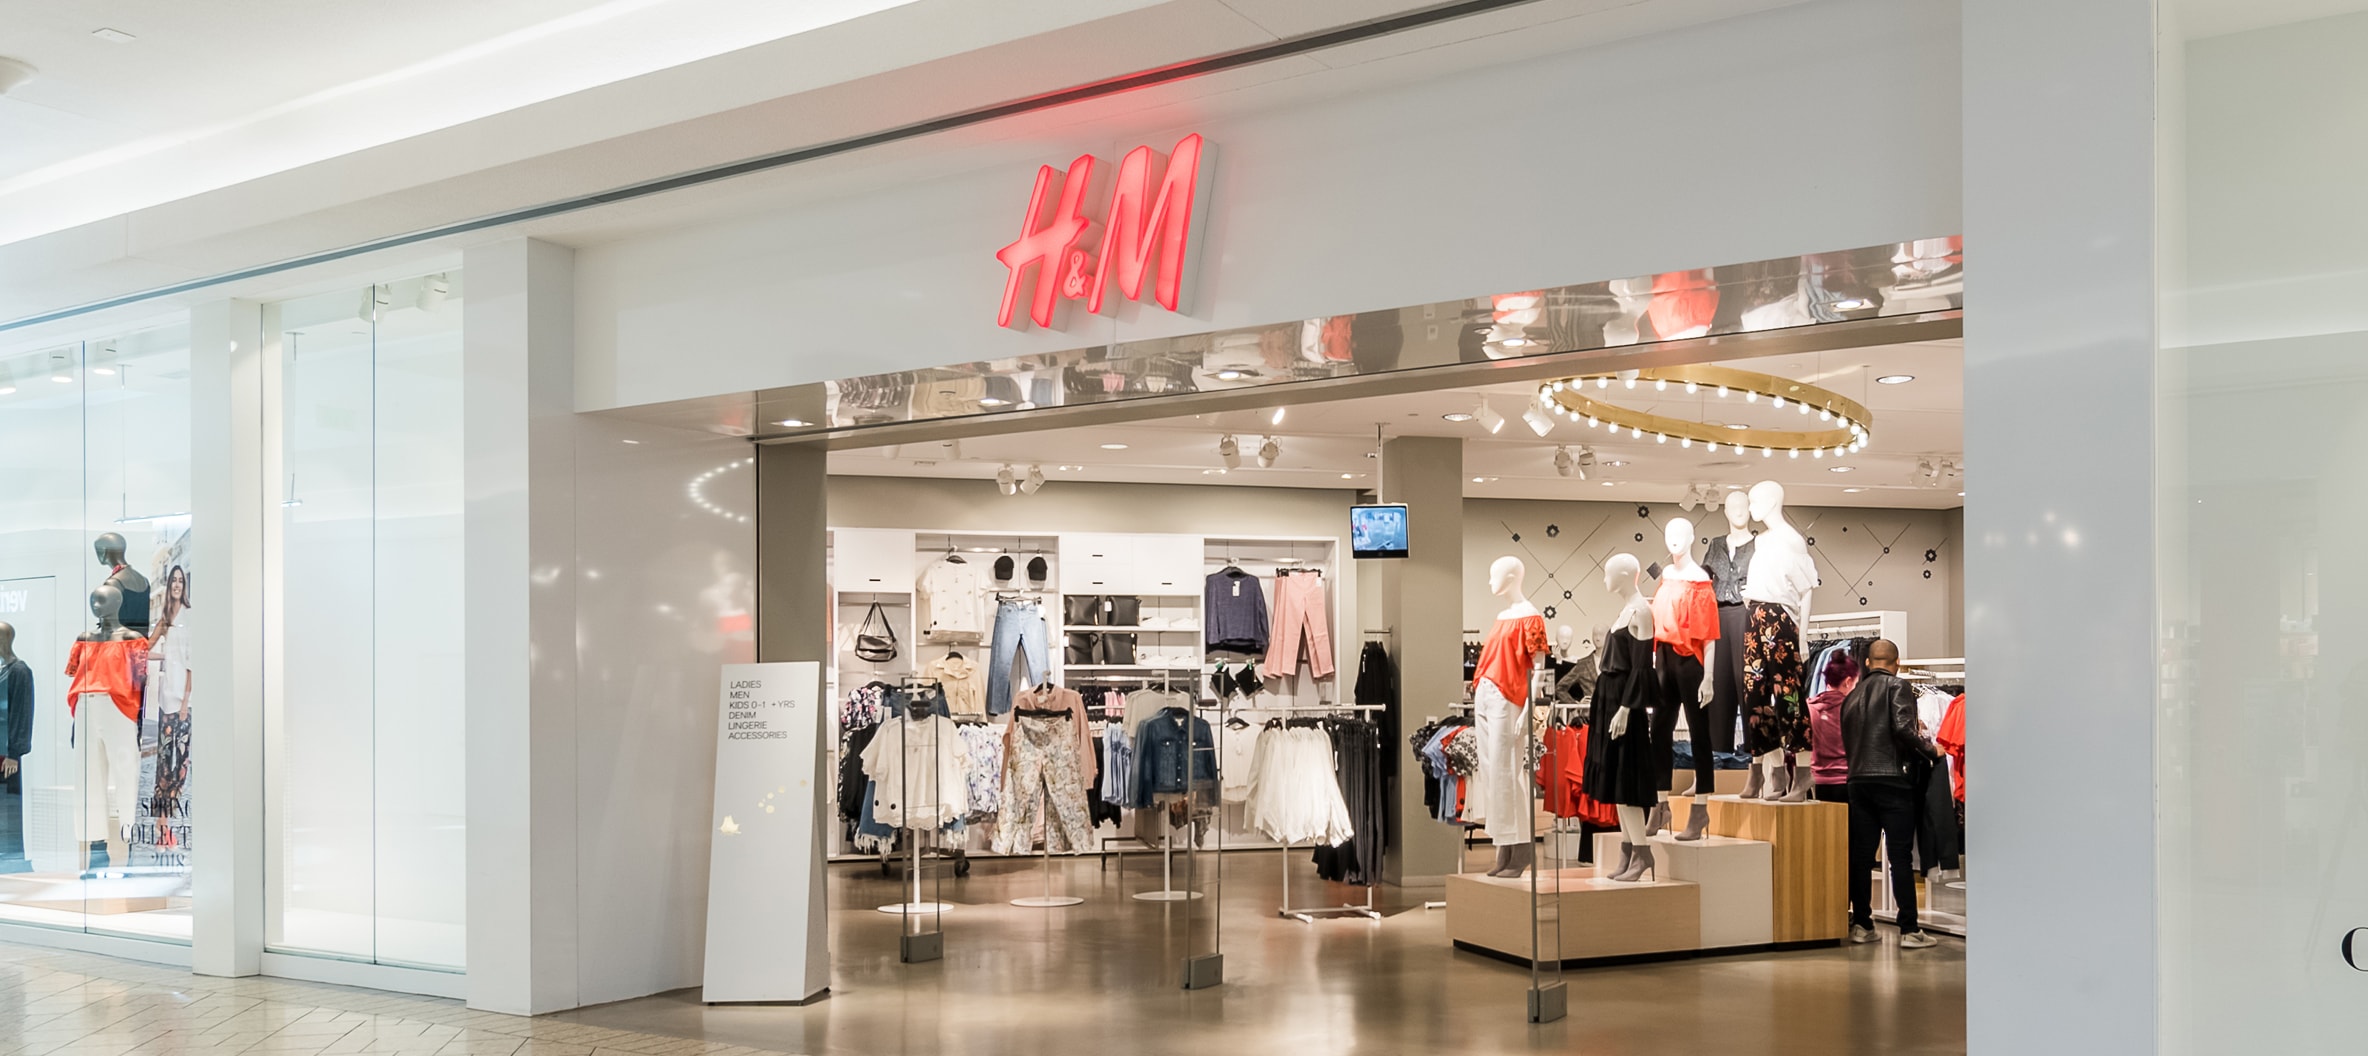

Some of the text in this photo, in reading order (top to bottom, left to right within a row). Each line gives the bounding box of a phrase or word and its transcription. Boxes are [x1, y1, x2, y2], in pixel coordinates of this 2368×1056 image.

[996, 132, 1204, 328] H&M
[730, 680, 762, 689] LADIES
[729, 691, 750, 699] MEN
[729, 701, 750, 709] KIDS
[728, 711, 757, 720] DENIM
[728, 721, 768, 730] LINGERIE
[728, 731, 788, 740] ACCESSORIES
